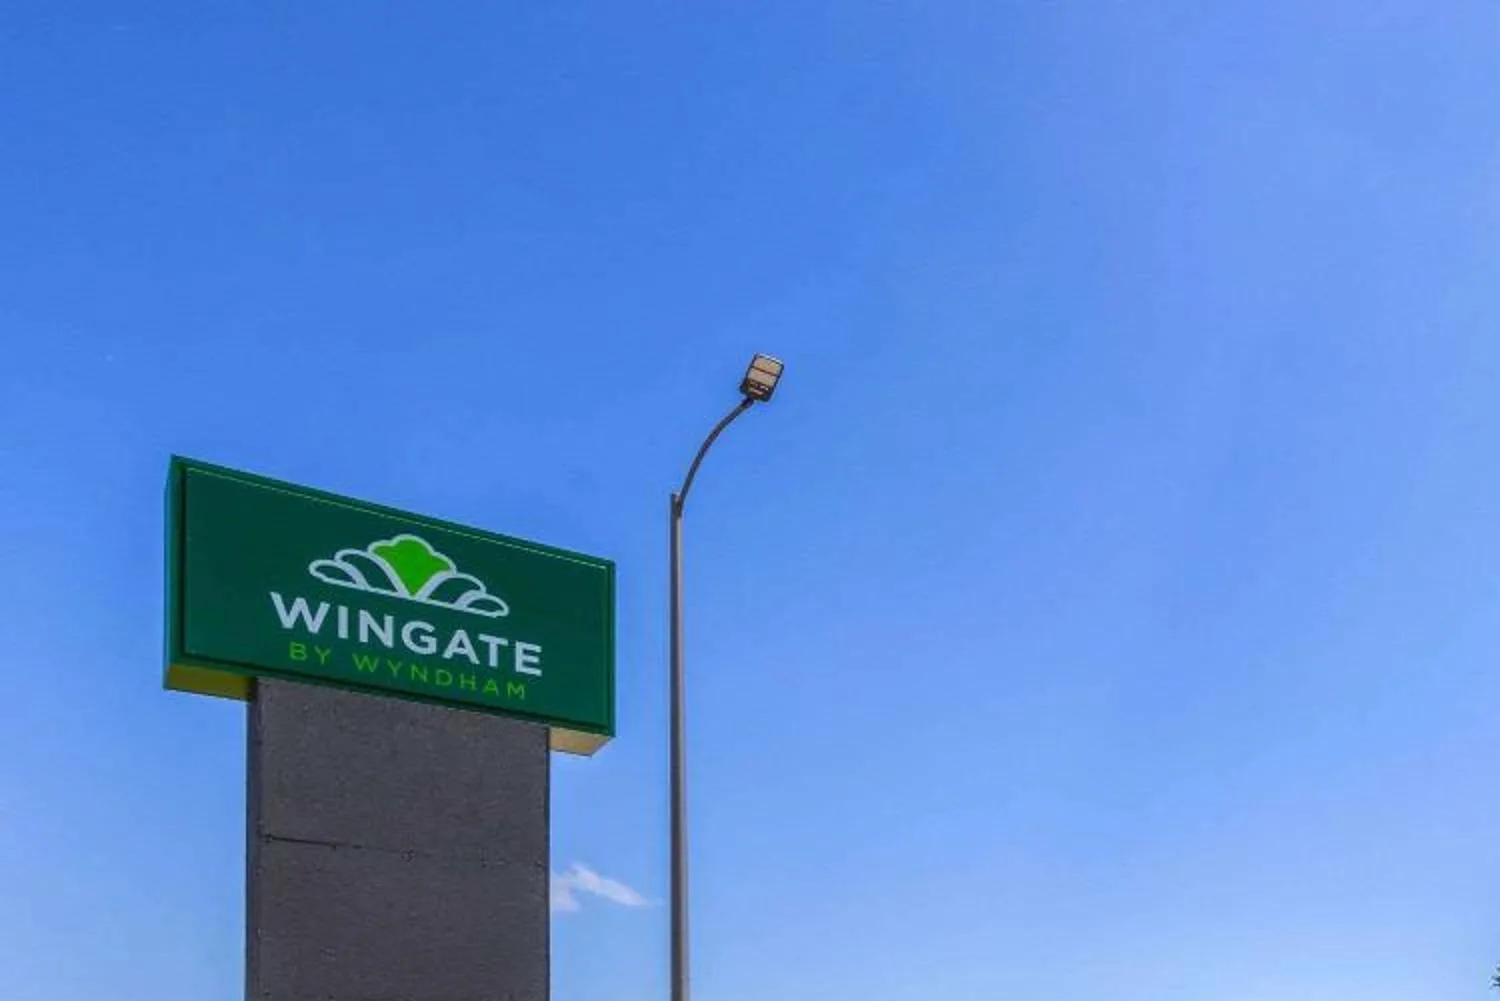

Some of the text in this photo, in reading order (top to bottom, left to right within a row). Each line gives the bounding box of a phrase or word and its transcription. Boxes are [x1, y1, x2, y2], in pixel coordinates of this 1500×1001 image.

[270, 591, 542, 676] WINGATE
[289, 641, 526, 700] BY WYNDHAM
